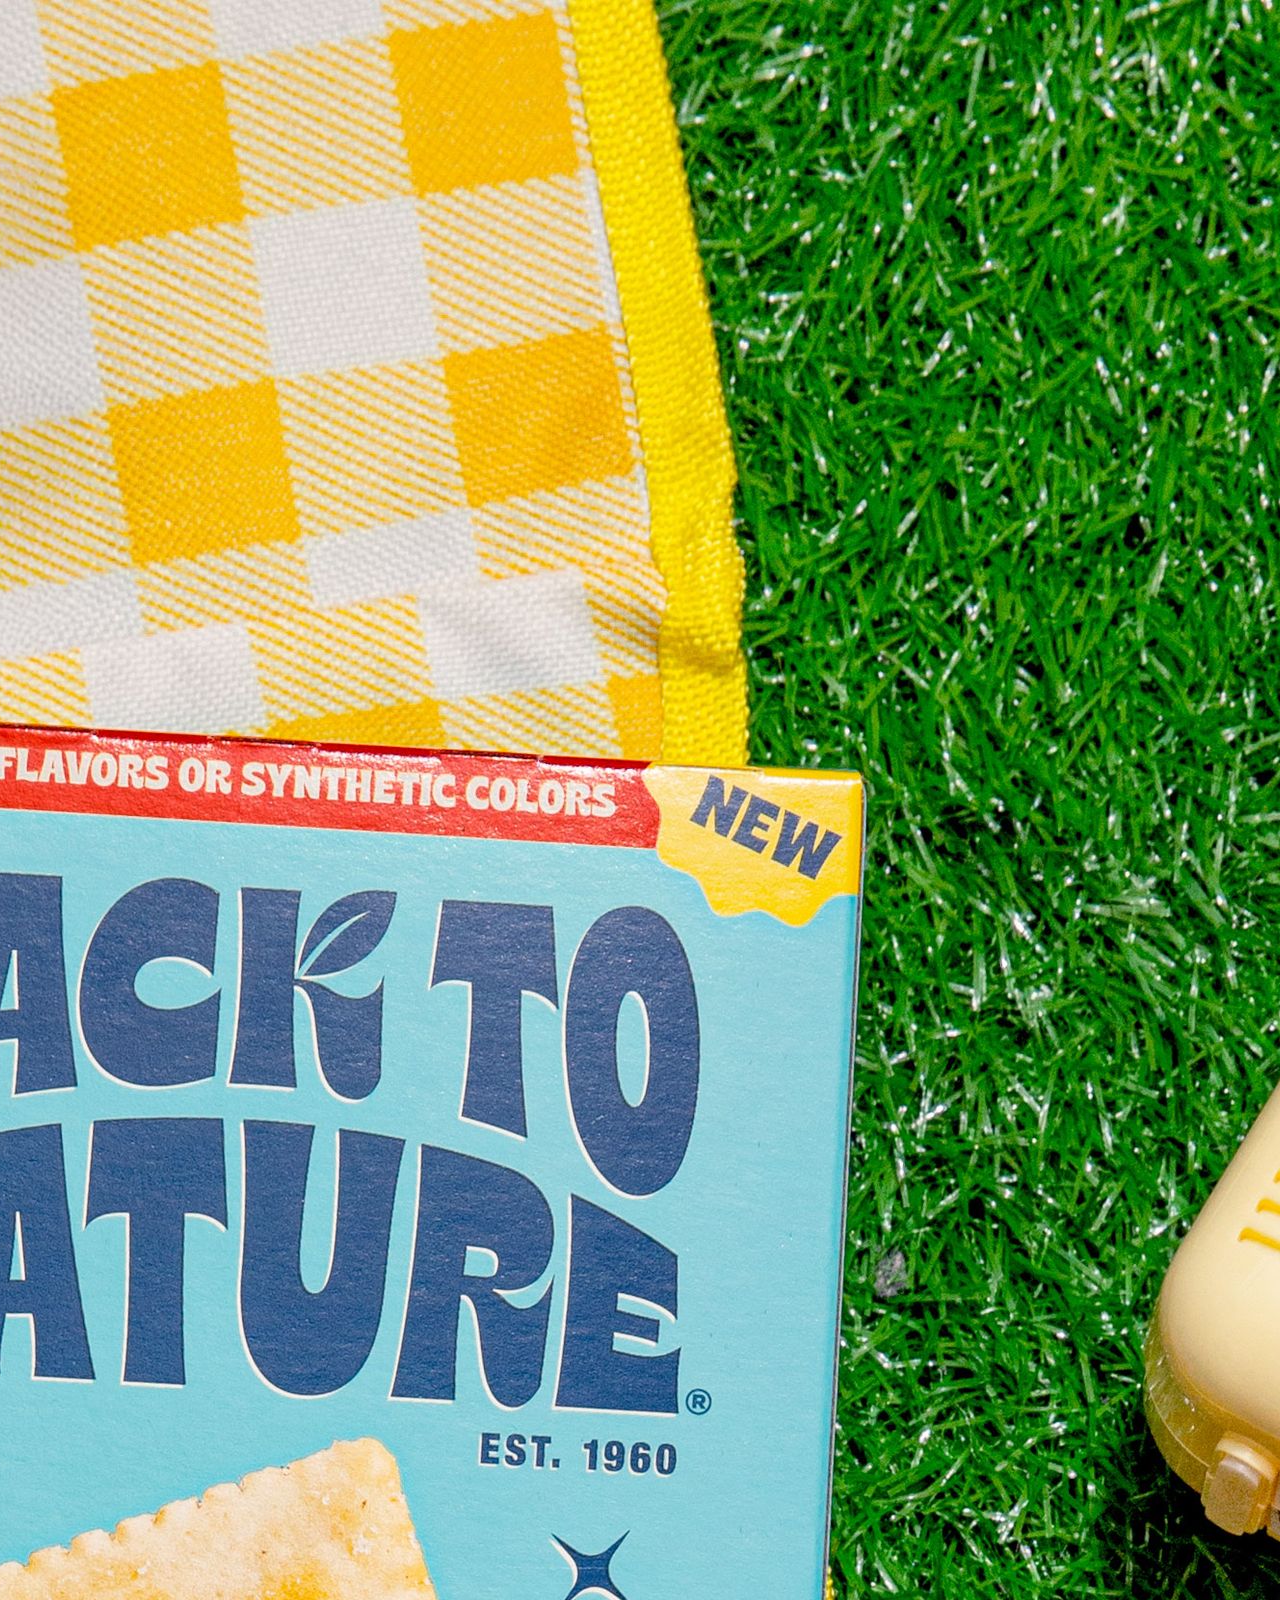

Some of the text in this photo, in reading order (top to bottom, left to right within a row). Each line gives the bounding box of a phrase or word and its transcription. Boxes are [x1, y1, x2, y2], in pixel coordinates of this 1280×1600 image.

[177, 758, 232, 795] OR
[240, 762, 458, 808] SYNTHETIC
[465, 775, 618, 818] COLORS
[689, 774, 844, 881] NEW
[430, 898, 702, 1198] TO
[479, 1432, 677, 1478] EST. 1960
